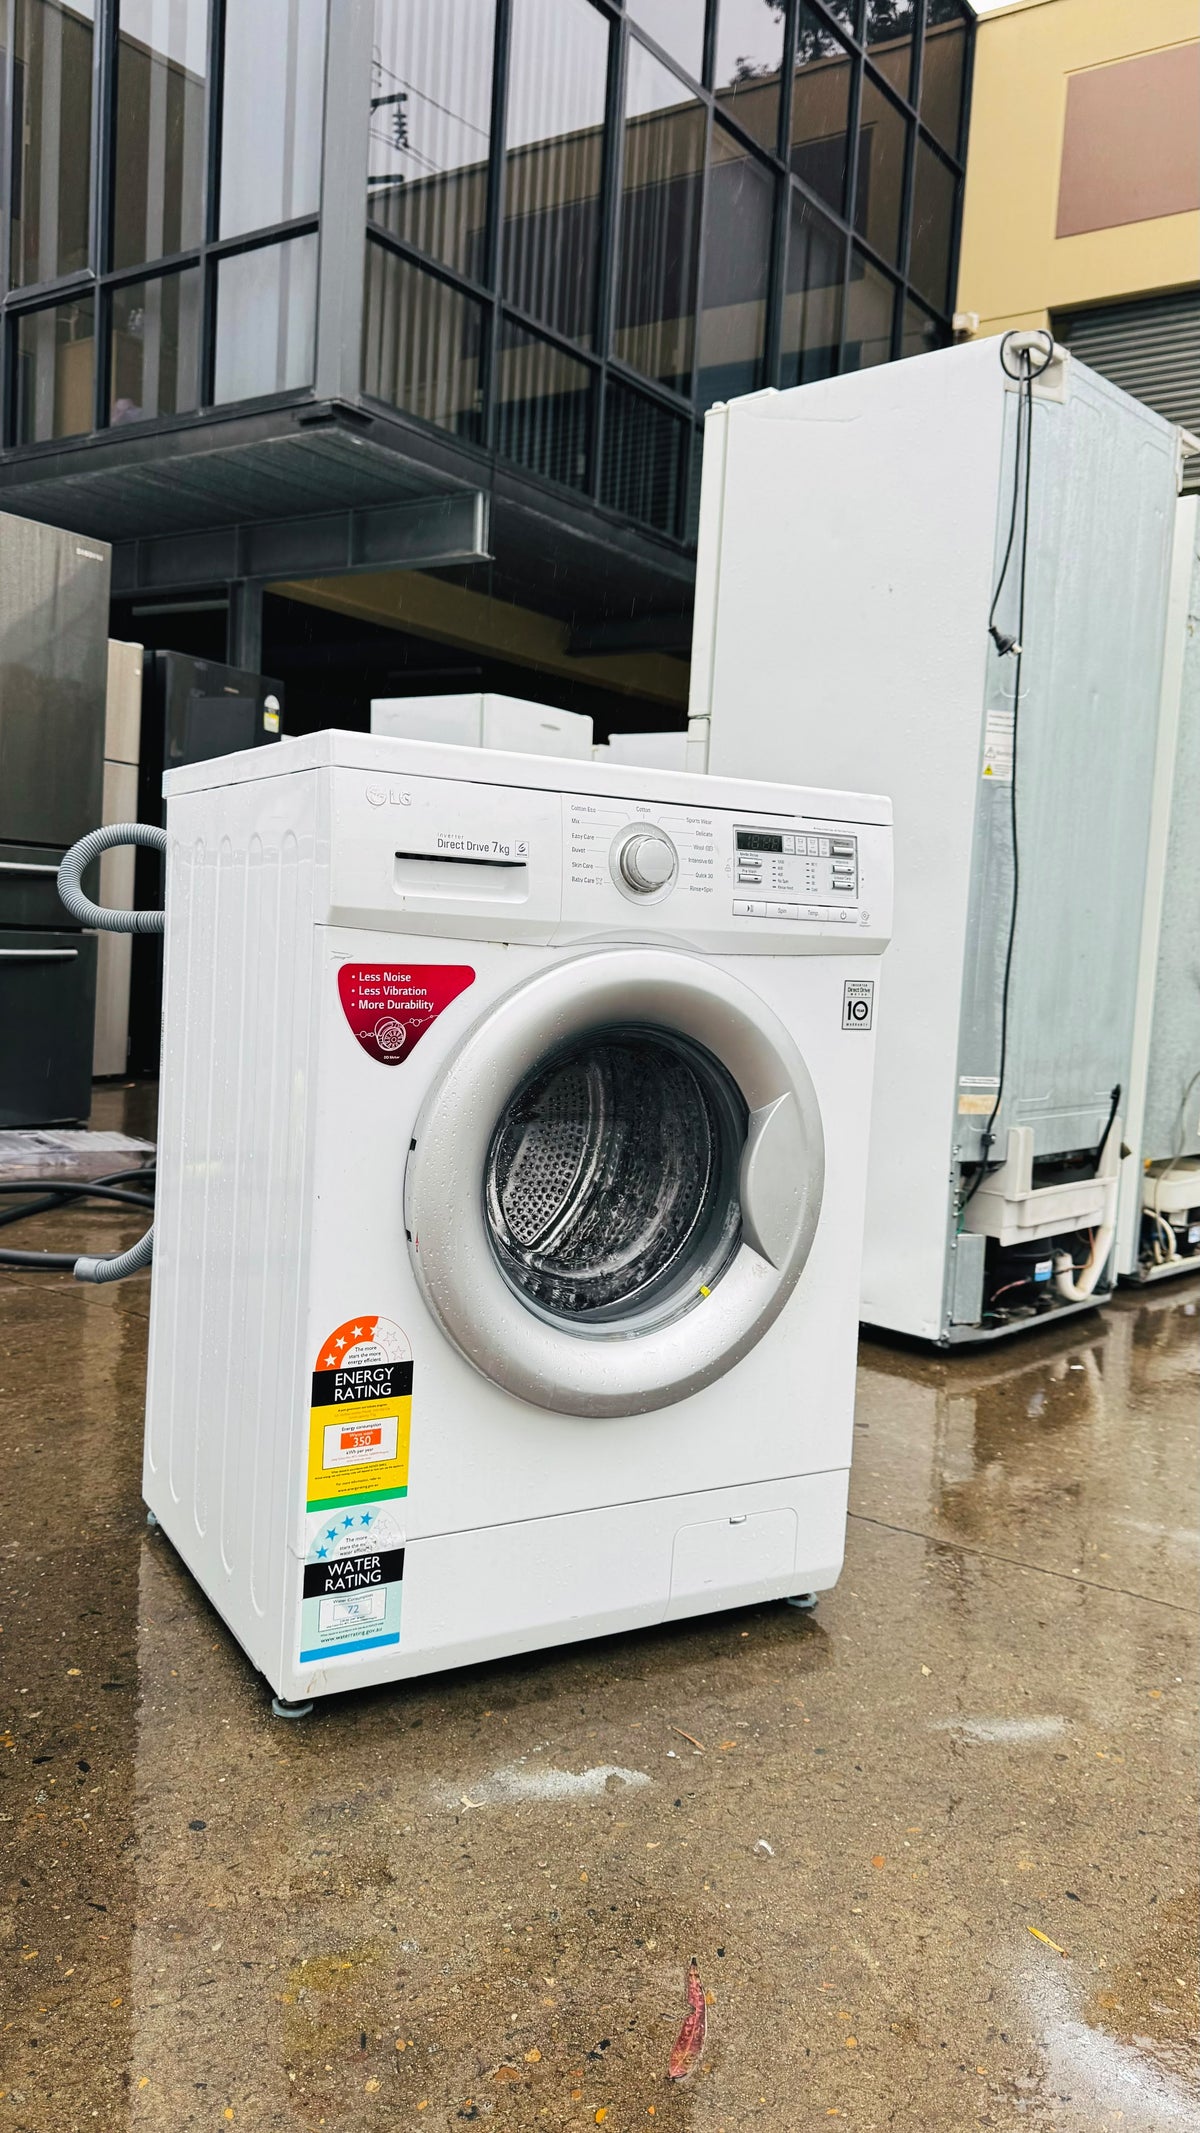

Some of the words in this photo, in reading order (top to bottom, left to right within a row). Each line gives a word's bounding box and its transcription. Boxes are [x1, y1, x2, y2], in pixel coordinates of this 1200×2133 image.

[389, 788, 412, 807] LG
[571, 832, 583, 841] Easy
[437, 838, 465, 851] Direct
[466, 841, 490, 853] Drive
[571, 861, 582, 869] Skin
[358, 971, 381, 982] Less
[383, 971, 411, 982] Noise
[358, 985, 381, 996] Less
[383, 985, 427, 996] Vibration
[358, 999, 385, 1009] More
[387, 999, 434, 1012] Durability
[848, 1000, 868, 1020] 10
[335, 1367, 394, 1386] ENERGY
[334, 1383, 392, 1402] RATING
[353, 1435, 372, 1448] 350
[328, 1557, 380, 1576] WATER
[325, 1570, 381, 1591] RATING
[347, 1604, 360, 1614] 72
[320, 1627, 383, 1643] www.waterrating.gov.au
